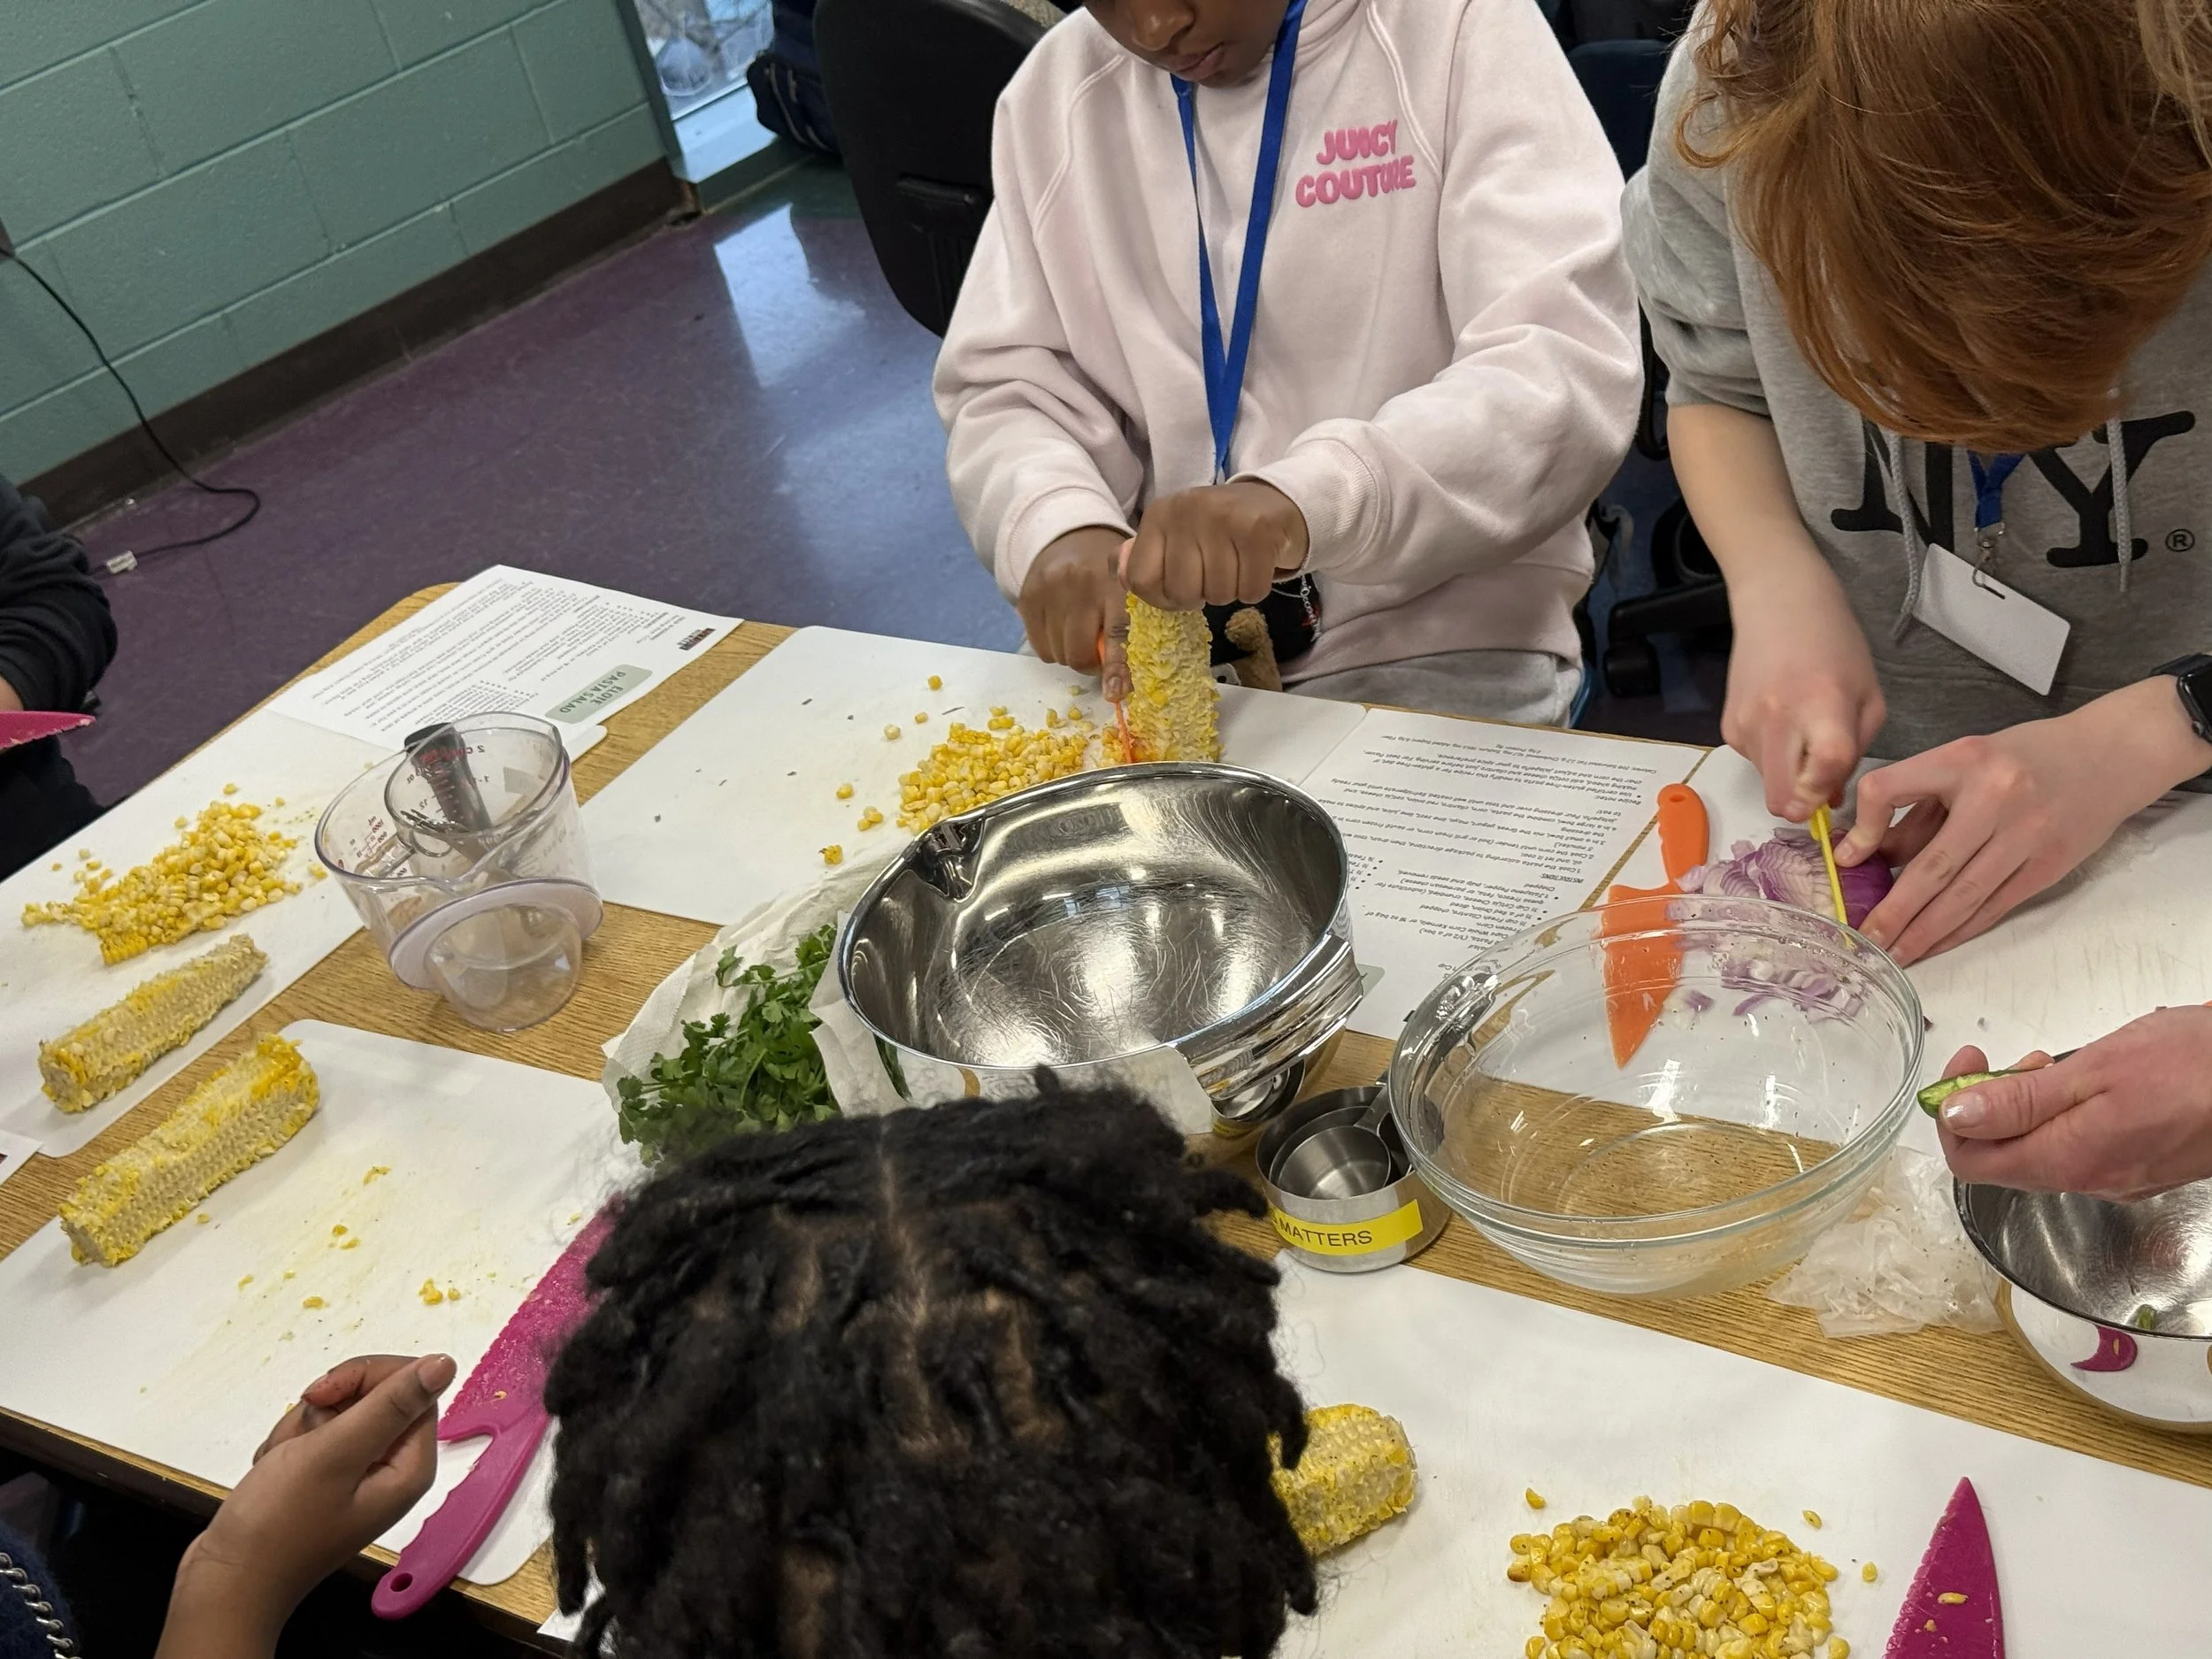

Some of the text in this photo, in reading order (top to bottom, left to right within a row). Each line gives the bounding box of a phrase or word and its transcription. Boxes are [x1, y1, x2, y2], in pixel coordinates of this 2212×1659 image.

[1316, 119, 1398, 165] JUICY
[1295, 155, 1417, 208] COUTURE
[559, 672, 626, 714] PASTA SALAD
[592, 686, 624, 706] ELOTE
[1279, 1221, 1373, 1247] MATTERS
